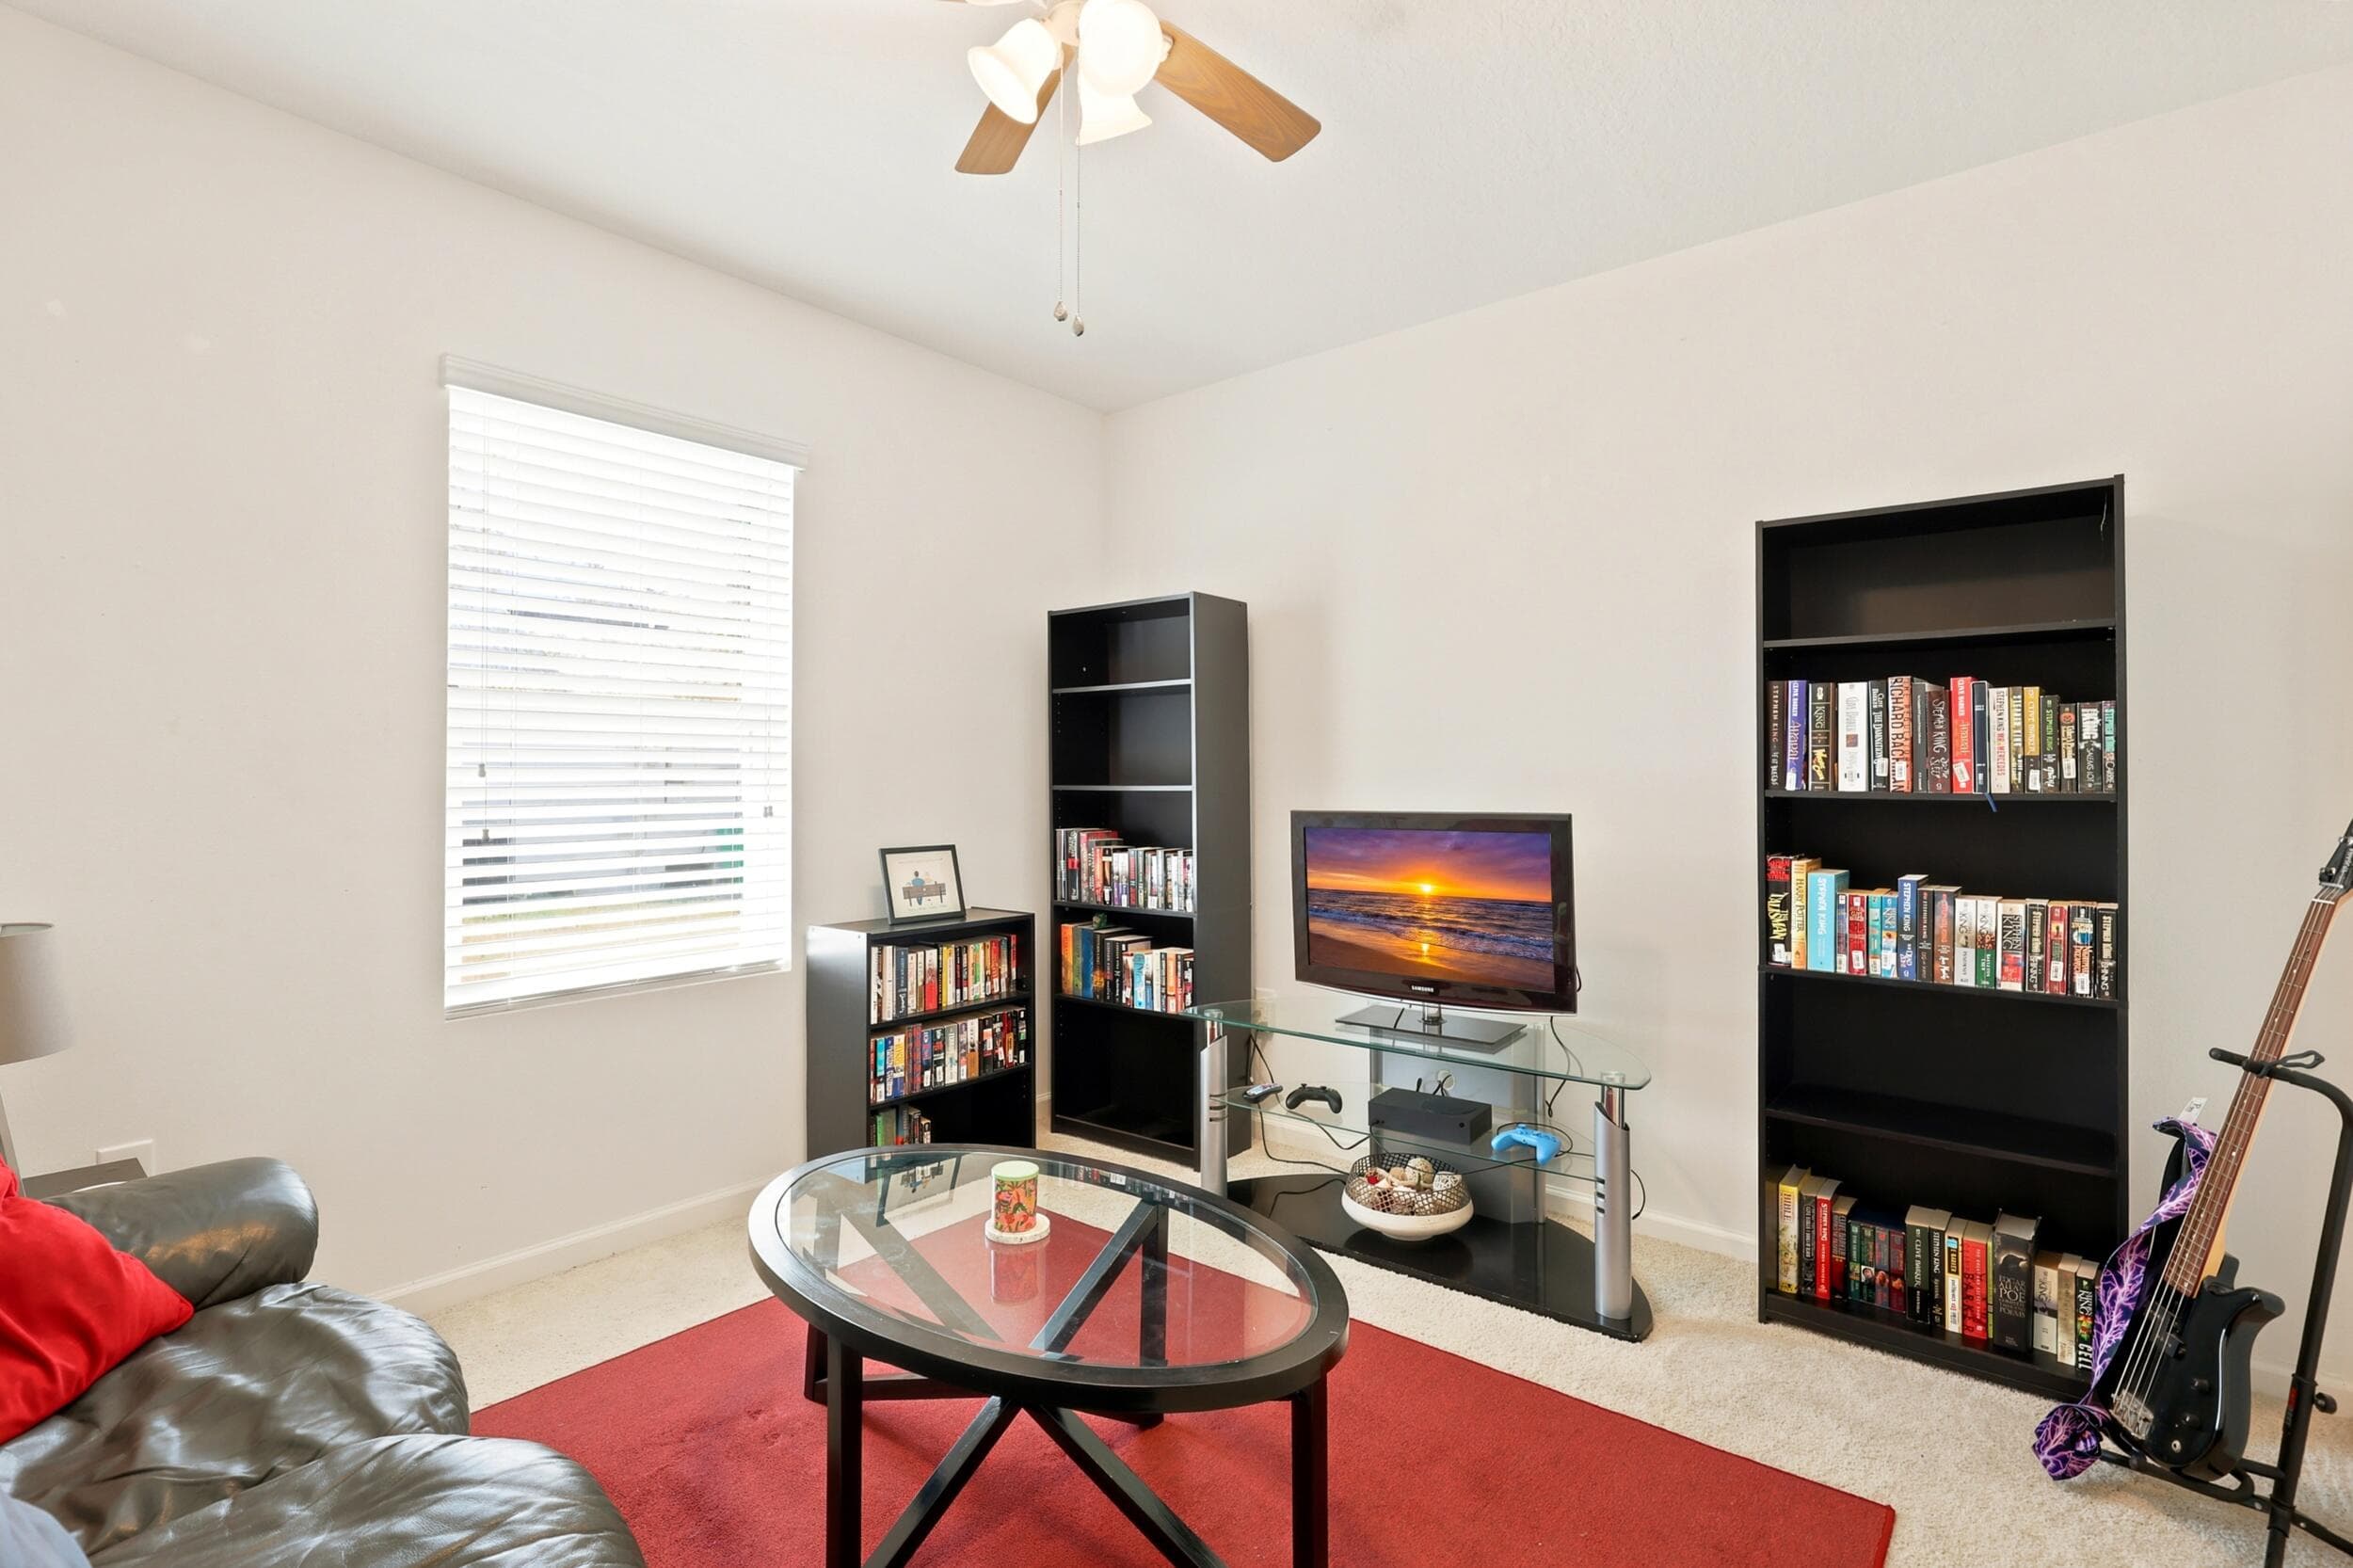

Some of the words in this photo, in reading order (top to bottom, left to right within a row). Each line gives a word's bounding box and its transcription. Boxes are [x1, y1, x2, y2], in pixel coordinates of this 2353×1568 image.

[1889, 676, 1905, 729] RICHARD
[1932, 698, 1945, 728] STEPHEN
[1995, 690, 2005, 716] STEPHEN
[1813, 706, 1826, 729] KING
[1873, 711, 1883, 724] THE
[1995, 717, 2005, 732] KING
[2045, 709, 2054, 735] STEPHEN
[1932, 730, 1947, 753] KING
[2045, 736, 2054, 751] KING
[1996, 745, 2006, 776] MERCEDES
[1796, 879, 1804, 903] HARRY
[1817, 877, 1827, 911] STEPHEN
[1903, 882, 1912, 913] STEPHEN
[1767, 892, 1790, 940] TALISMAN
[1795, 904, 1804, 932] POTTER
[1817, 913, 1827, 935] KING
[1903, 914, 1912, 932] KING
[2032, 911, 2041, 936] STEPHEN
[2103, 916, 2113, 942] STEPHEN
[2002, 916, 2013, 950] KING
[2012, 915, 2023, 951] STEPHEN
[1411, 984, 1434, 993] SAMSUNG
[1963, 1272, 1975, 1334] BARKER
[1999, 1288, 2025, 1304] POE
[2077, 1289, 2091, 1316] KING
[2077, 1342, 2093, 1369] CELL
